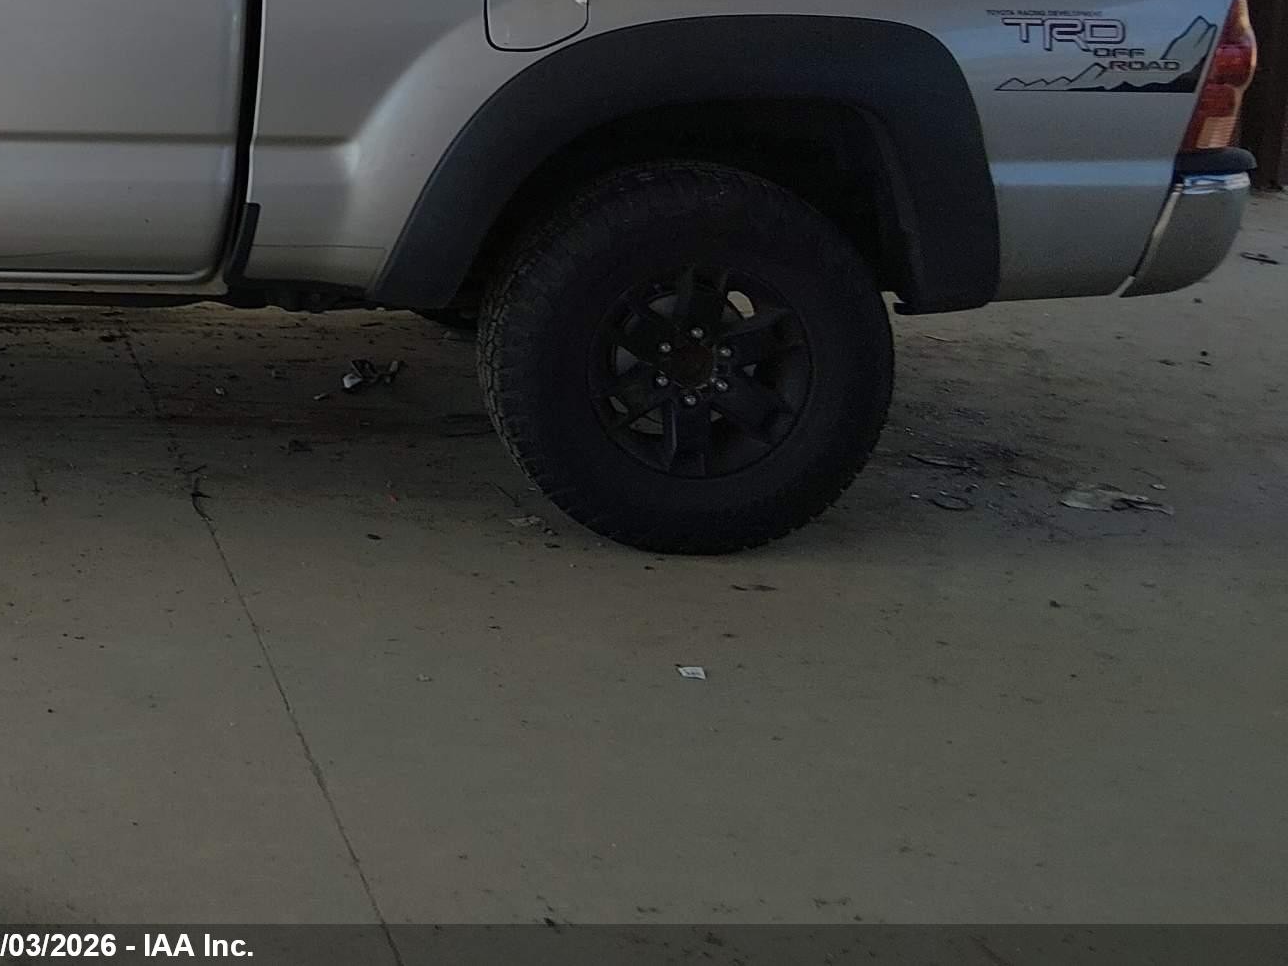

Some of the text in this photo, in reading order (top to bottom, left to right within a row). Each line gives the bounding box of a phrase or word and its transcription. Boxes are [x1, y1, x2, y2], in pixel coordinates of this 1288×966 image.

[1001, 17, 1126, 52] TRD
[1091, 47, 1145, 59] OFF
[1108, 60, 1181, 72] ROAD
